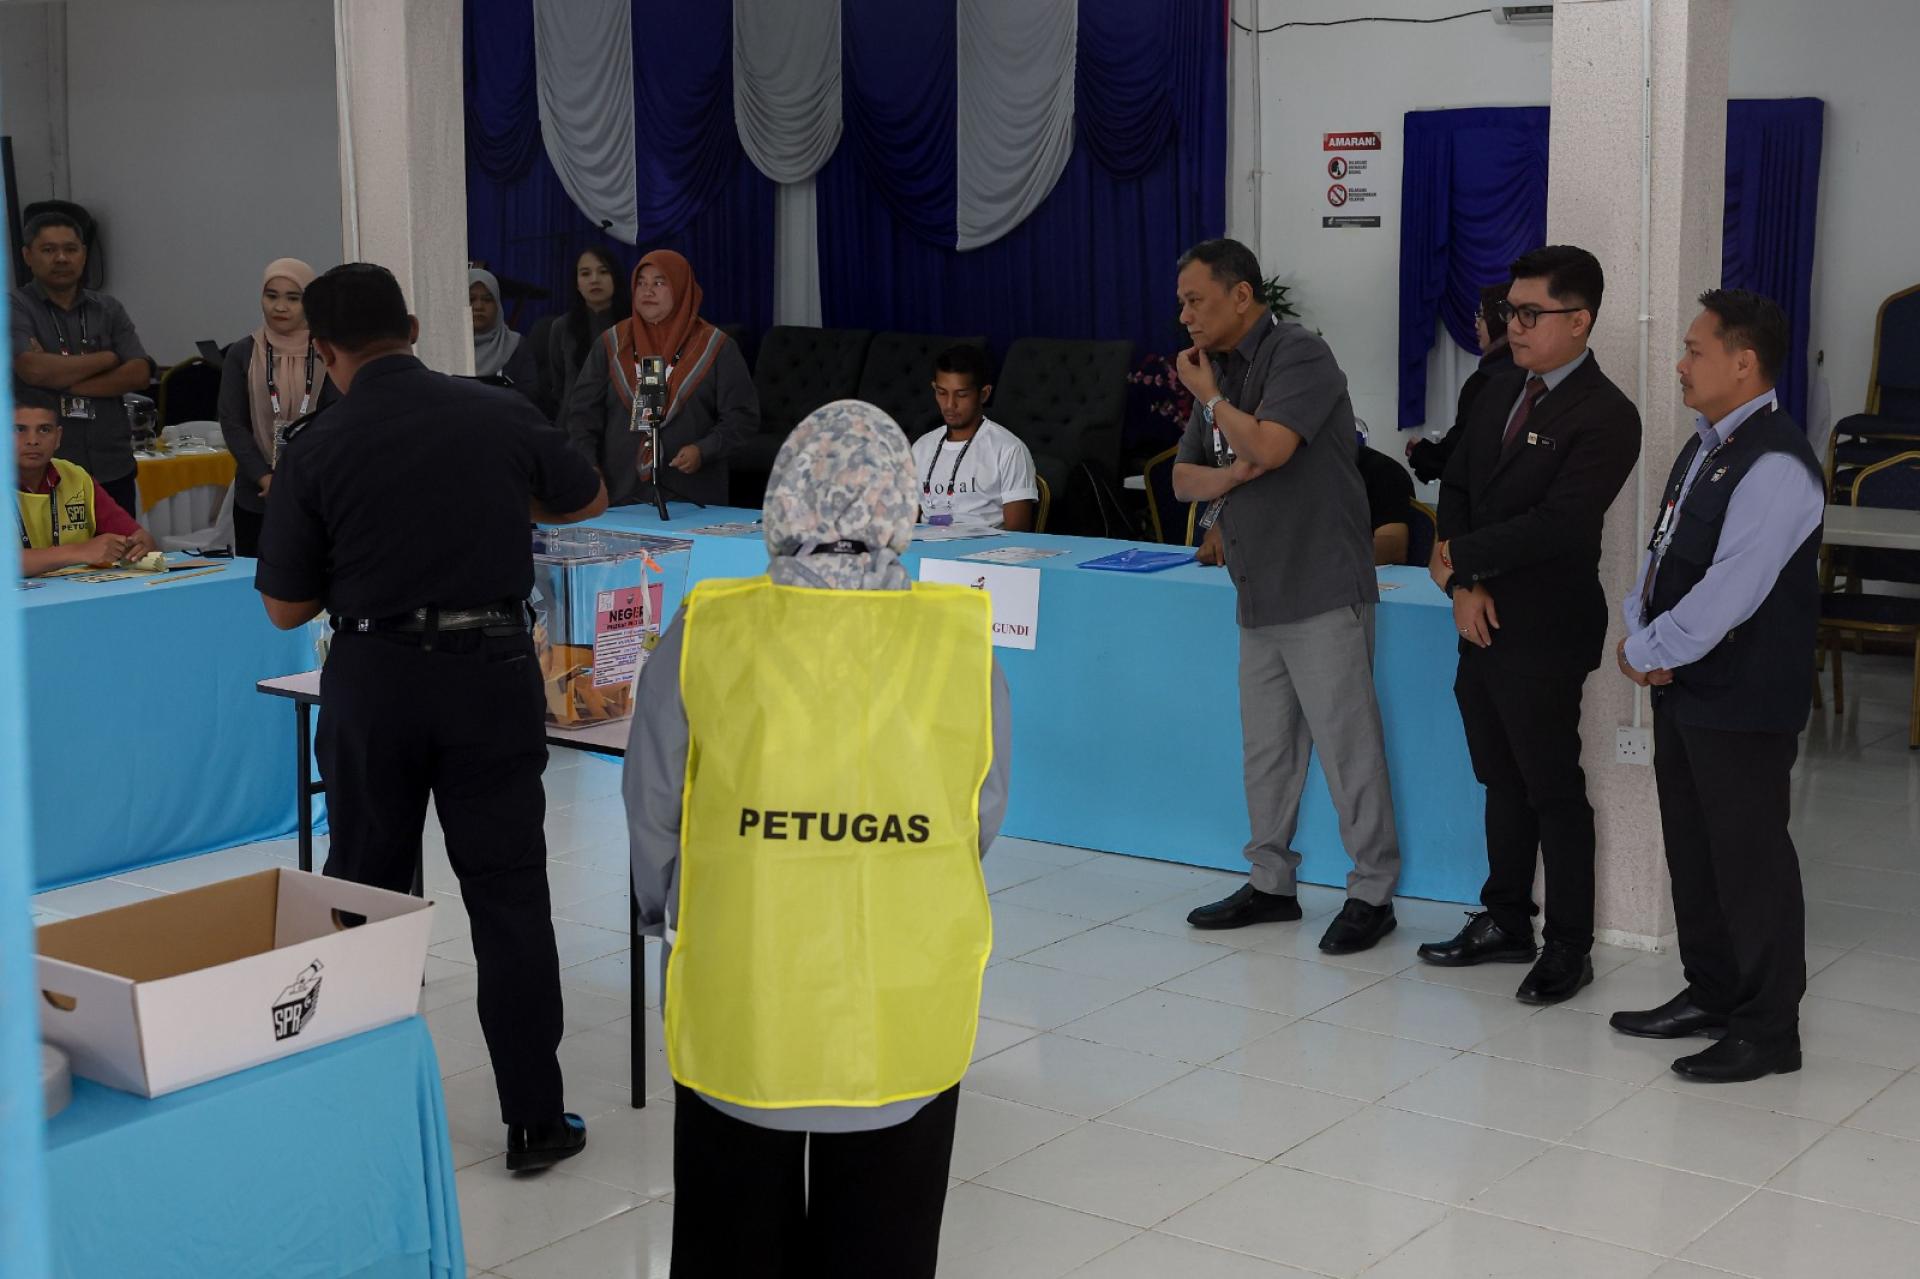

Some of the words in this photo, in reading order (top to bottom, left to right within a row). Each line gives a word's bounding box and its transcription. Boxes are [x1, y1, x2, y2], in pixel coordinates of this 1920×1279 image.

[1328, 137, 1376, 147] AMARAN!
[609, 606, 644, 622] NEGER
[992, 623, 1029, 637] GUNDI
[739, 808, 930, 843] PETUGAS
[274, 1003, 302, 1038] SPR
